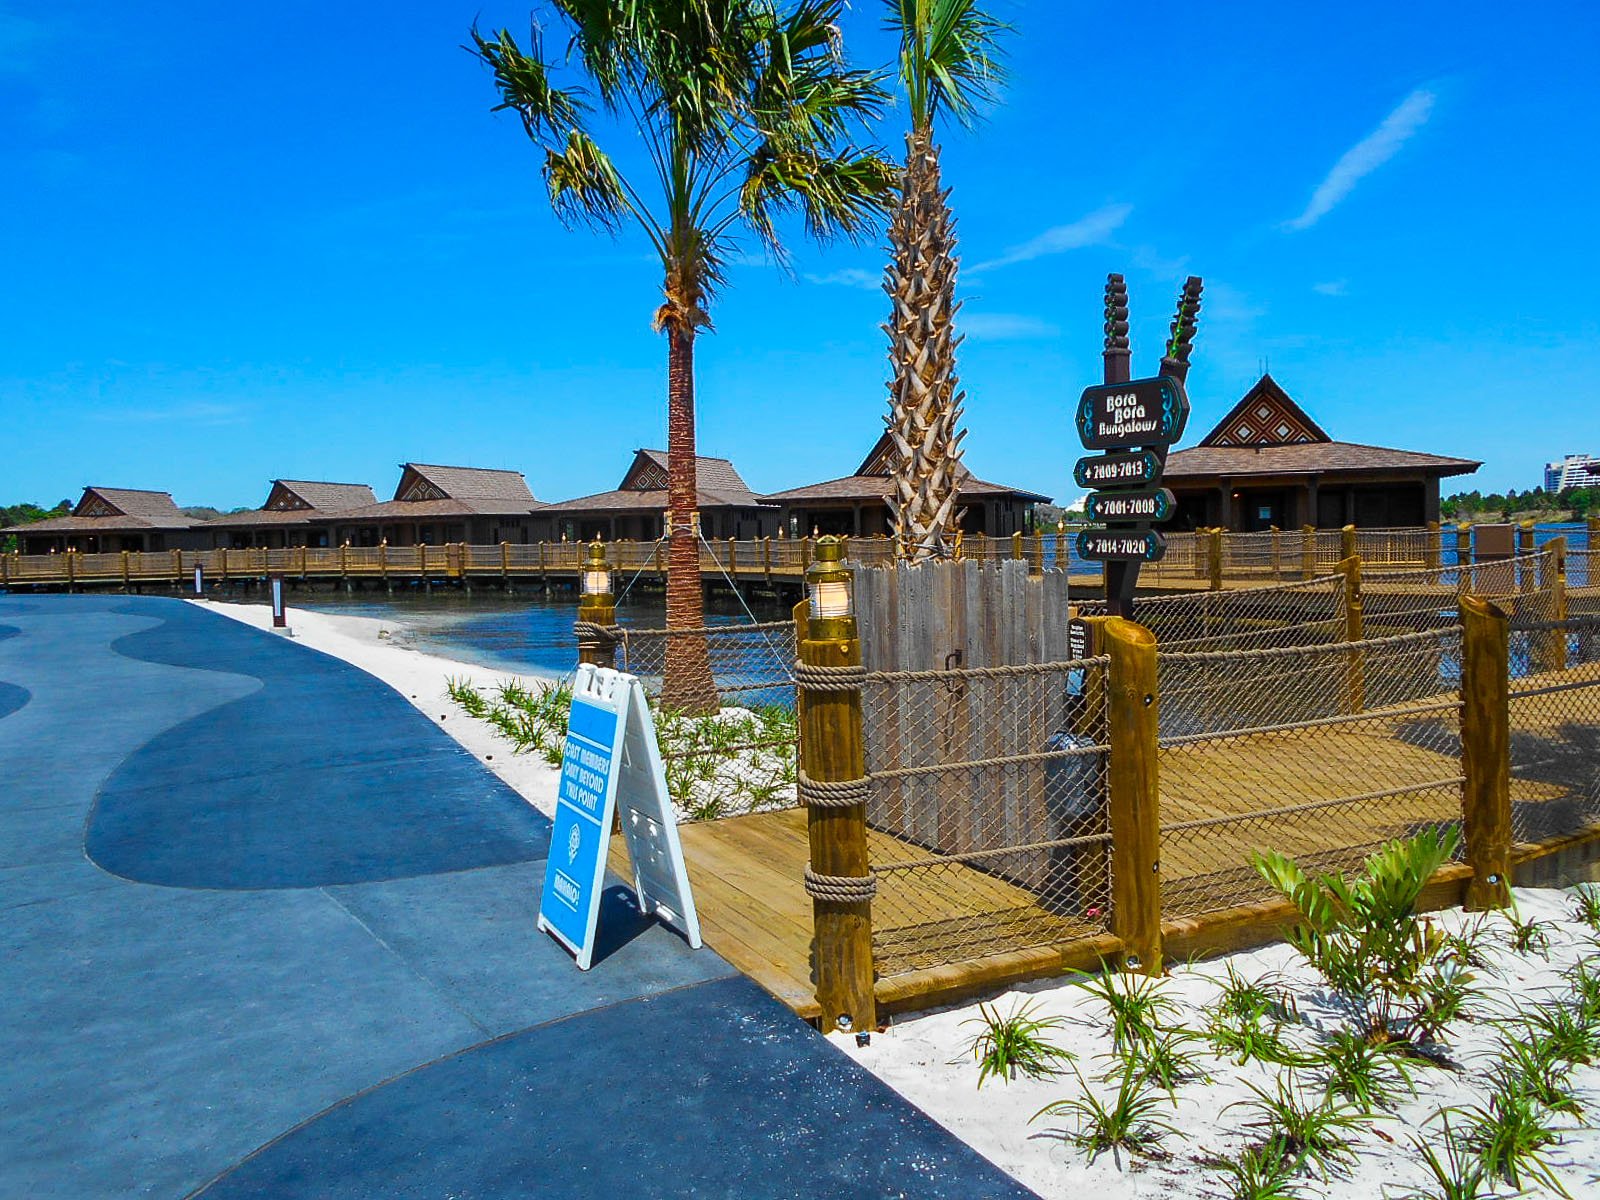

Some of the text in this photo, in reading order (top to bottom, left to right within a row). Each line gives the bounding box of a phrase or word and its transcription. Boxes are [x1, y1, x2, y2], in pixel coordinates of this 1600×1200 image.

[1106, 393, 1137, 413] Bora
[1114, 404, 1146, 424] Bora
[1099, 419, 1158, 438] Bungalows
[565, 741, 609, 775] CAST MEMBERS
[578, 768, 604, 794] BEYOND
[565, 780, 598, 811] THIS POINT
